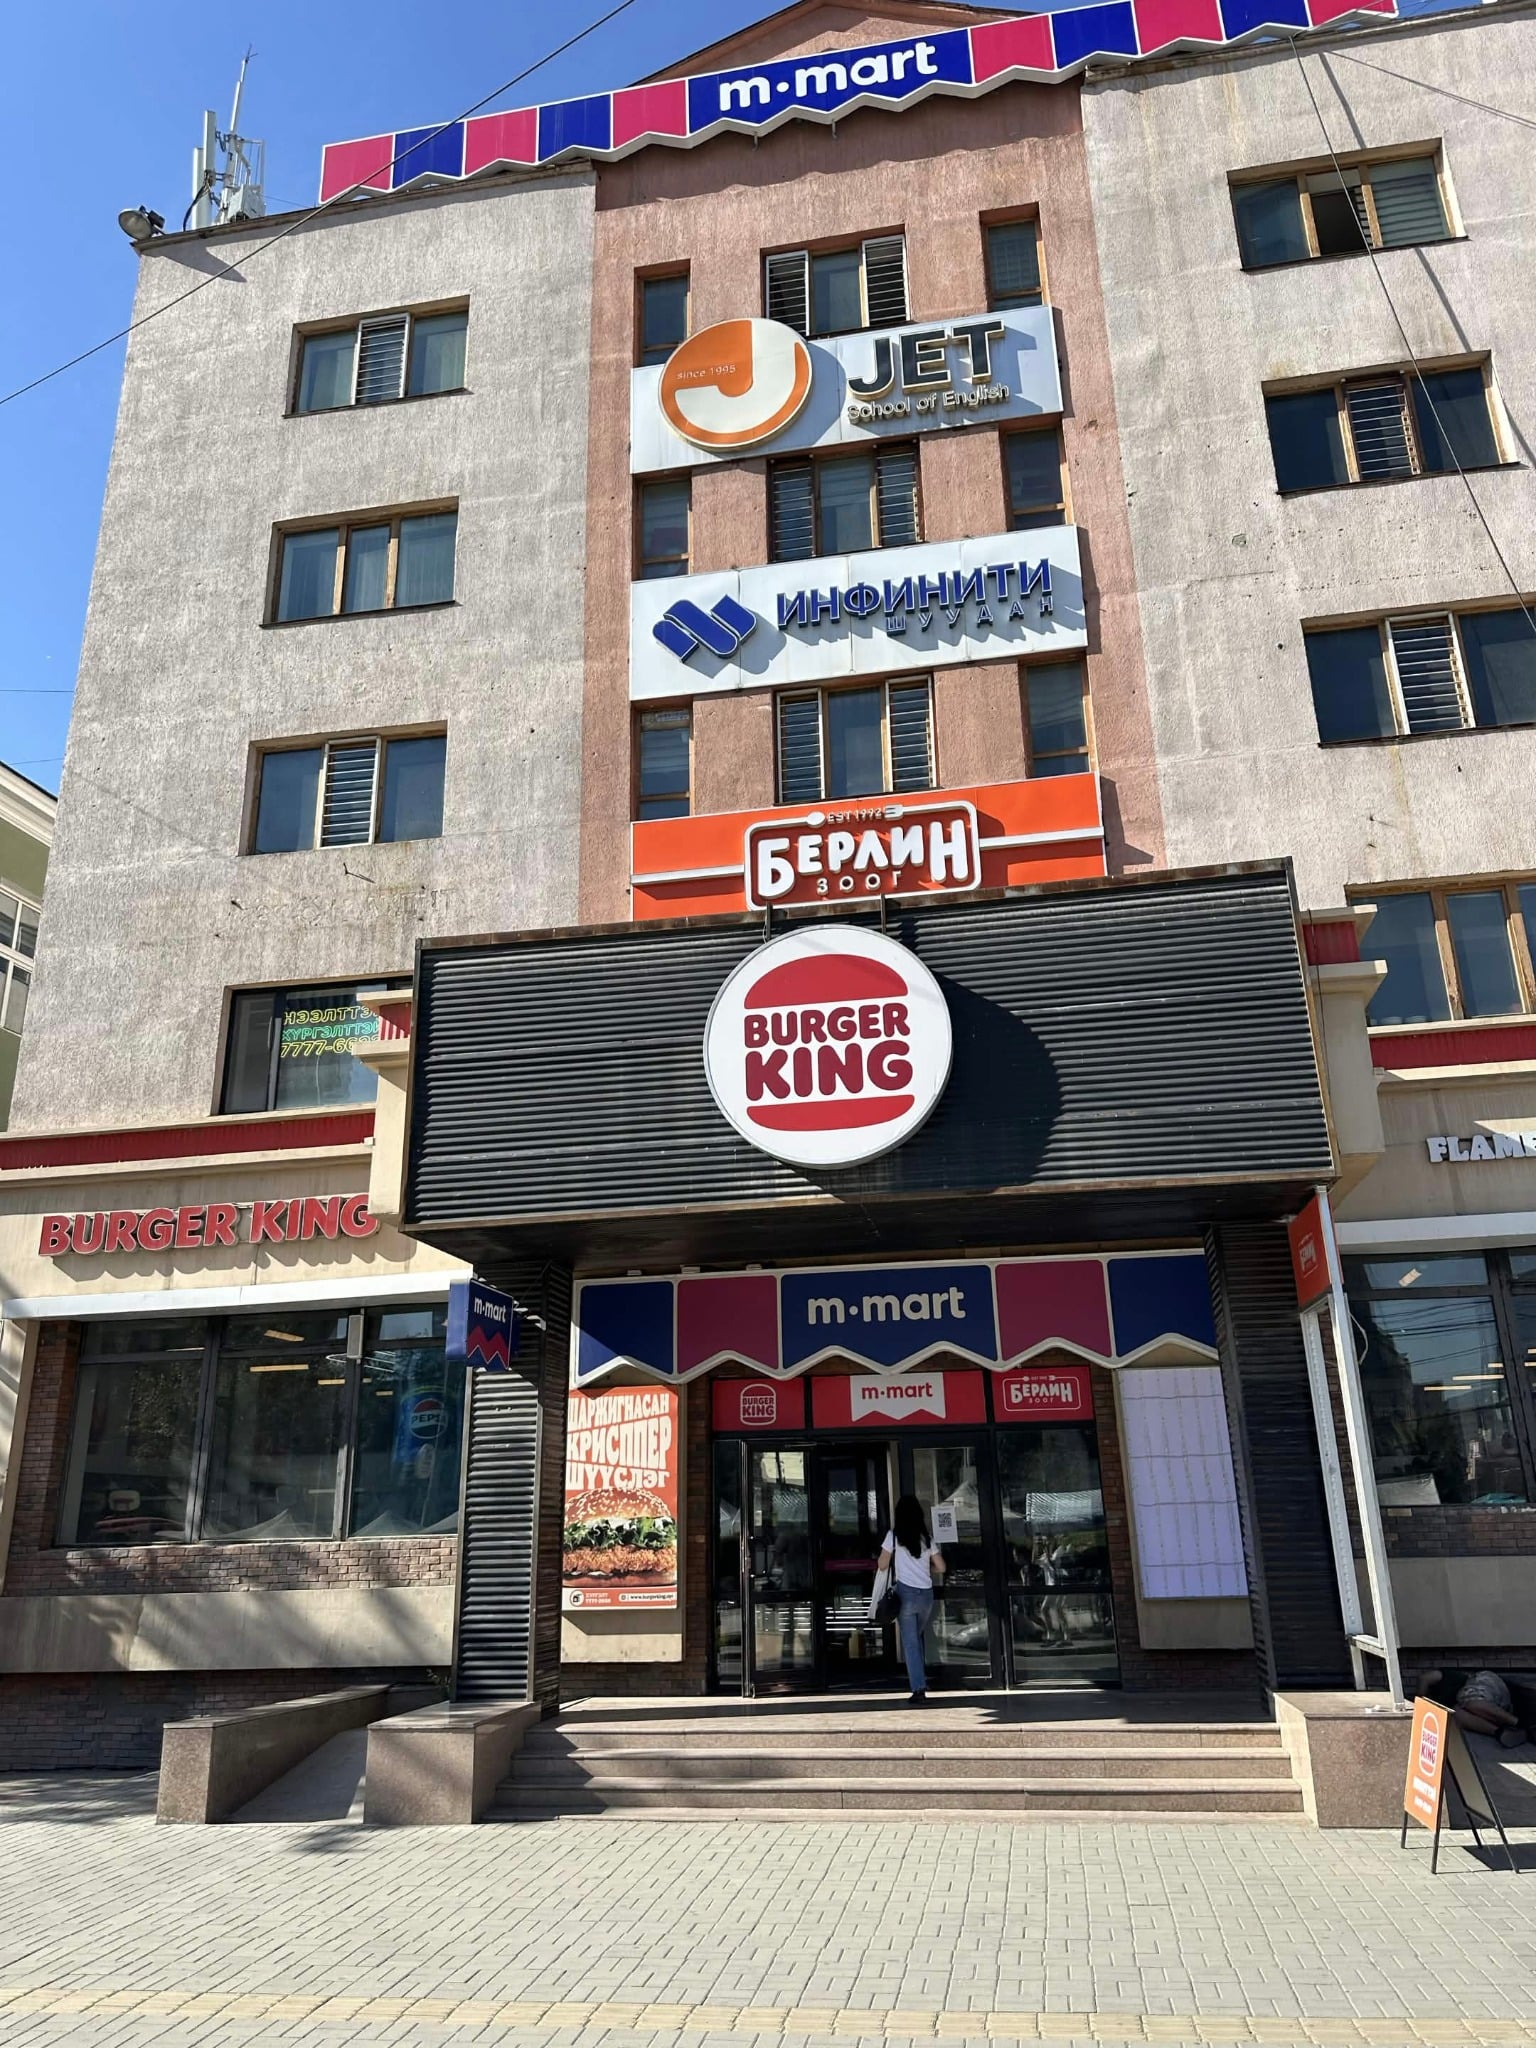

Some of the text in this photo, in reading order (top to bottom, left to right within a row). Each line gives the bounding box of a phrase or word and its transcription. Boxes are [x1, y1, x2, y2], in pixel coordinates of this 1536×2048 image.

[676, 363, 737, 380] since 1995
[848, 319, 1005, 399] JET
[848, 383, 1010, 424] School of English
[776, 558, 1054, 631] ИНФИНИТИ
[885, 595, 1054, 636] ШУУДАН
[828, 807, 882, 824] EST 1992
[757, 819, 969, 899] БЕРЛИН
[816, 871, 903, 896] ЗООГ
[283, 1005, 380, 1026] НЭЭЛТТЭ
[743, 1002, 911, 1049] BURGER
[745, 1039, 913, 1102] KING
[38, 1193, 380, 1257] BURGER KING
[742, 1396, 775, 1405] BURGER
[742, 1404, 775, 1416] KING
[1010, 1382, 1073, 1404] БЕРЛИН
[567, 1392, 670, 1432] ШАРЖИГНАСАН
[567, 1416, 673, 1470] КРИСППЕР
[566, 1460, 670, 1491] ШҮҮСЛЭГ
[1421, 1743, 1436, 1765] KING
[1422, 1729, 1438, 1747] BURGER
